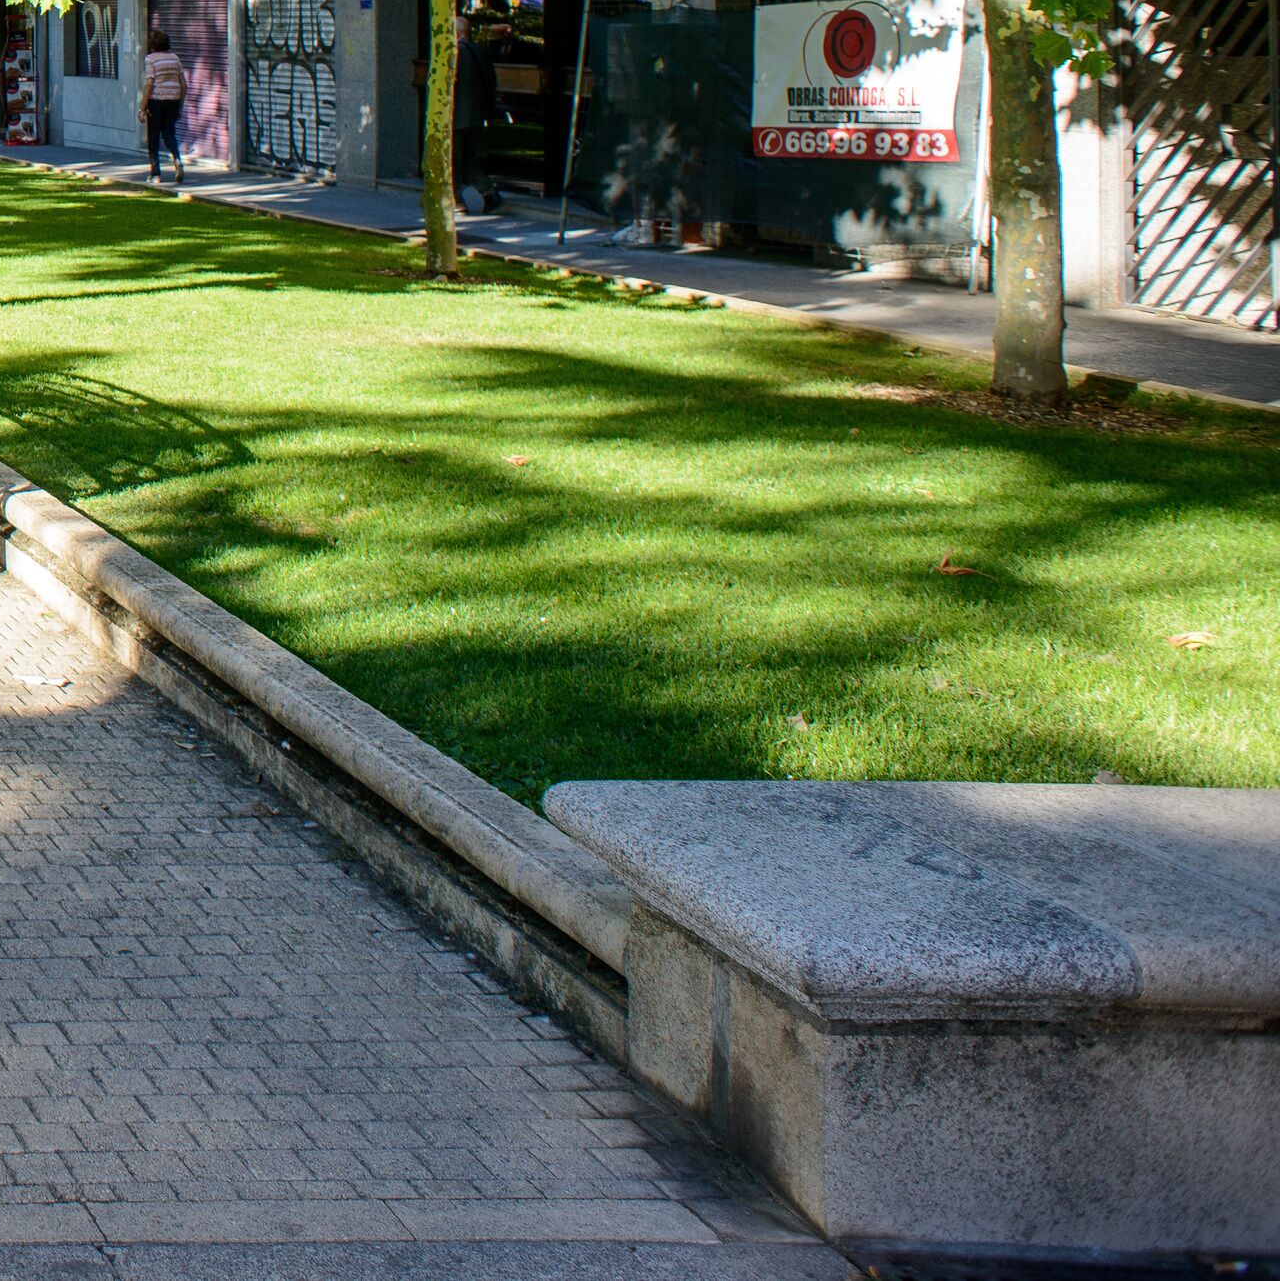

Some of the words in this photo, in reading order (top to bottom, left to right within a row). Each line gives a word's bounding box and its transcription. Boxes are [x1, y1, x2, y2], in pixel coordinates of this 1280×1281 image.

[898, 87, 920, 106] S.L.
[785, 131, 830, 154] 669
[833, 131, 867, 154] 96
[874, 132, 910, 156] 93
[915, 132, 949, 157] 83
